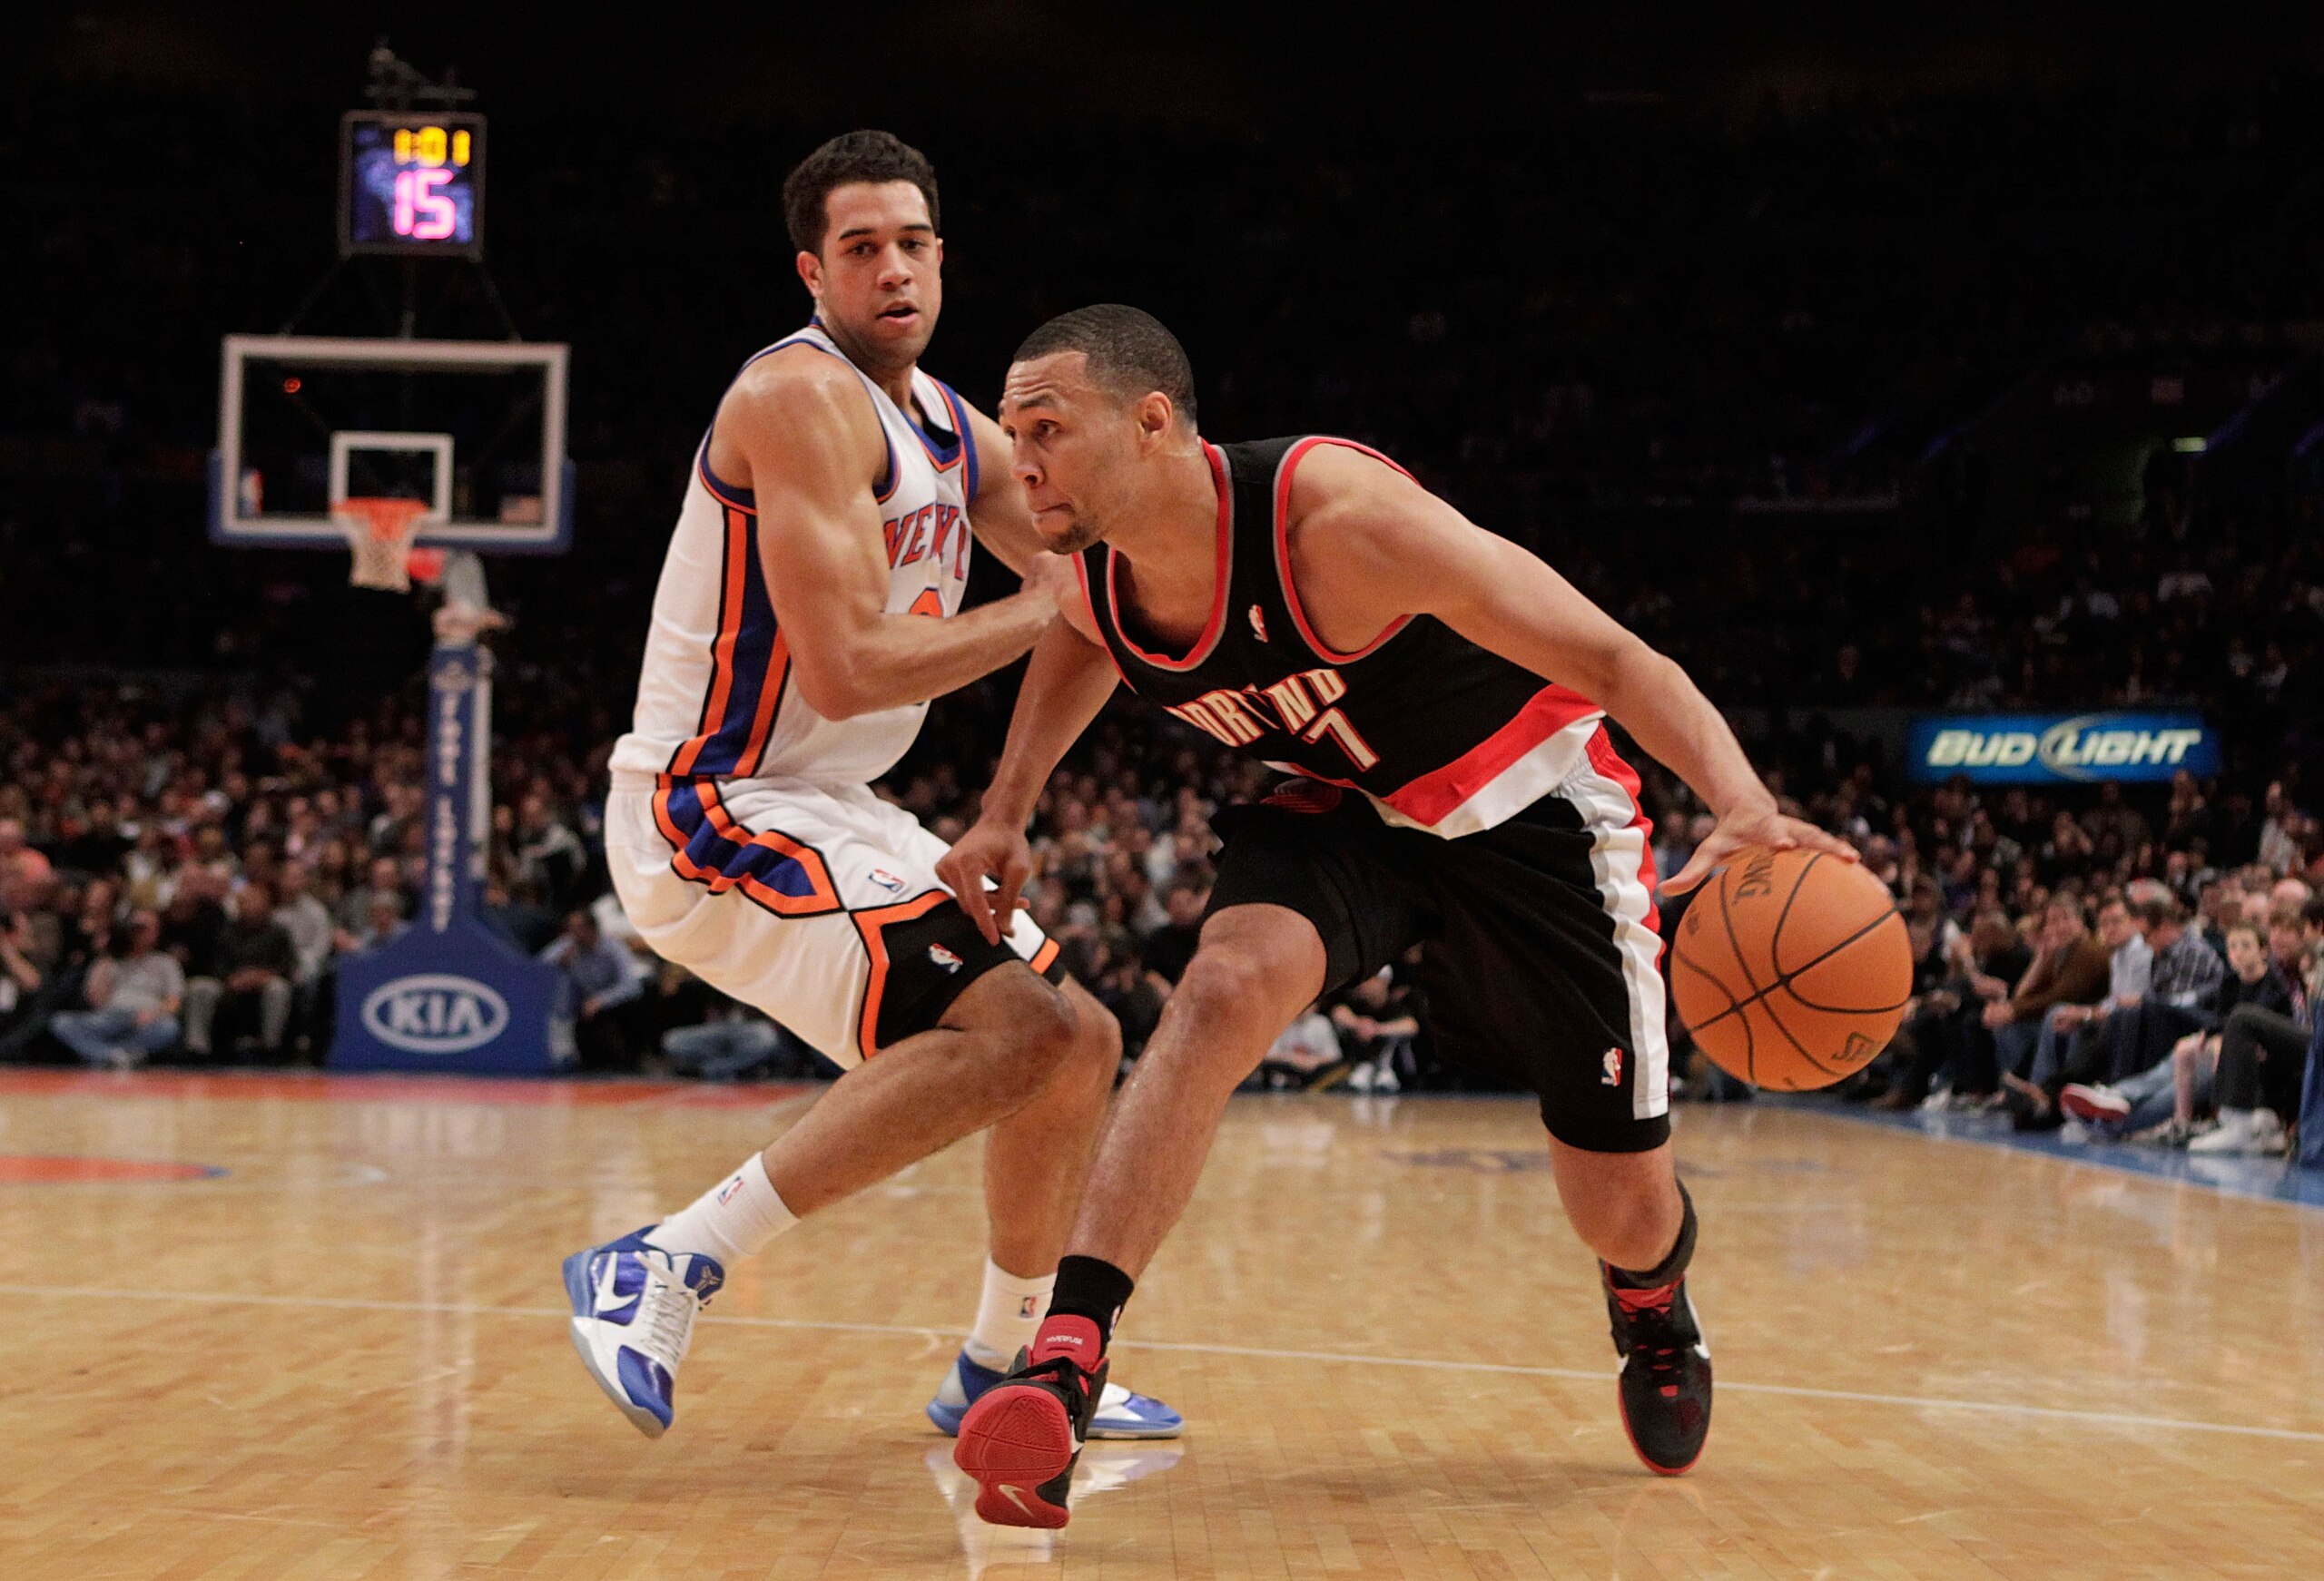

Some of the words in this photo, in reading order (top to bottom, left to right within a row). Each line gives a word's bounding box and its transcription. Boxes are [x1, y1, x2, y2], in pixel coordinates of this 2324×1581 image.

[394, 168, 457, 239] 15
[1302, 706, 1381, 772] 7
[1926, 729, 2039, 767] BUD
[2053, 729, 2202, 766] LIGHT
[389, 995, 487, 1035] KIA
